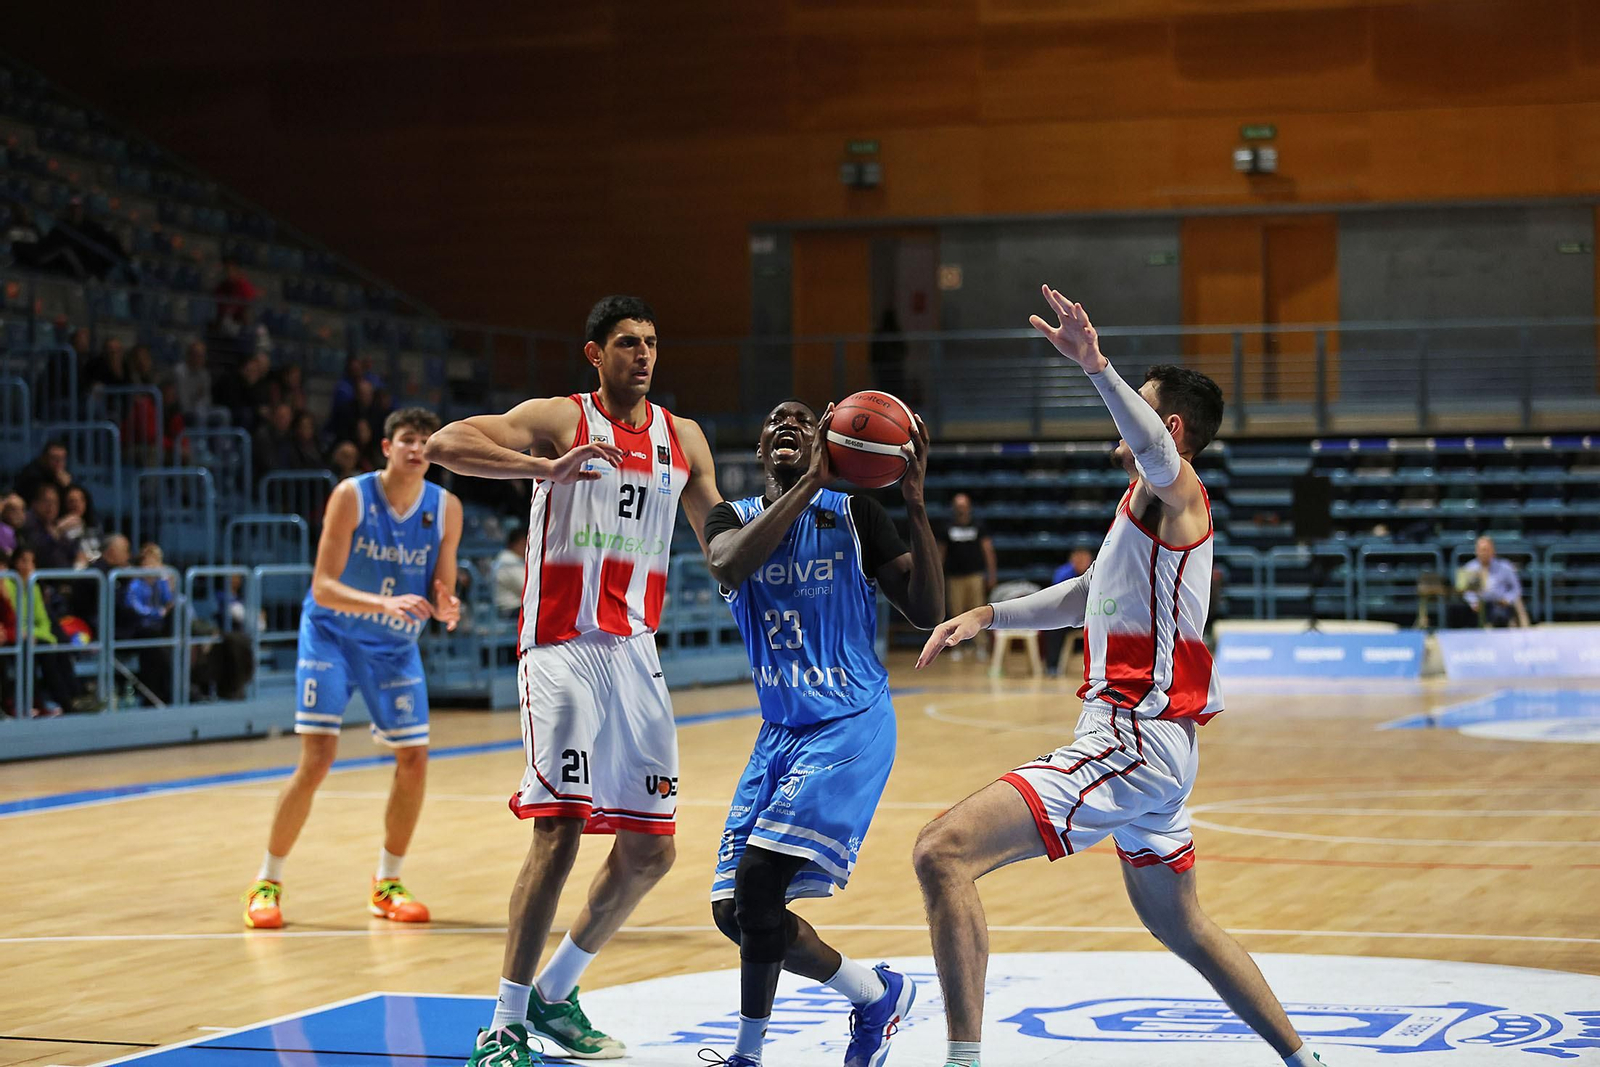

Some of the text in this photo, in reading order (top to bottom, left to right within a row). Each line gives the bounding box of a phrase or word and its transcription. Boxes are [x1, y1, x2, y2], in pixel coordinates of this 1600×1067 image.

[618, 483, 647, 521] 21
[354, 536, 428, 566] Huelva
[750, 556, 834, 585] uelva
[380, 576, 396, 598] 6
[793, 584, 834, 599] original
[764, 609, 803, 650] 23
[303, 678, 318, 708] 6
[561, 749, 590, 785] 21
